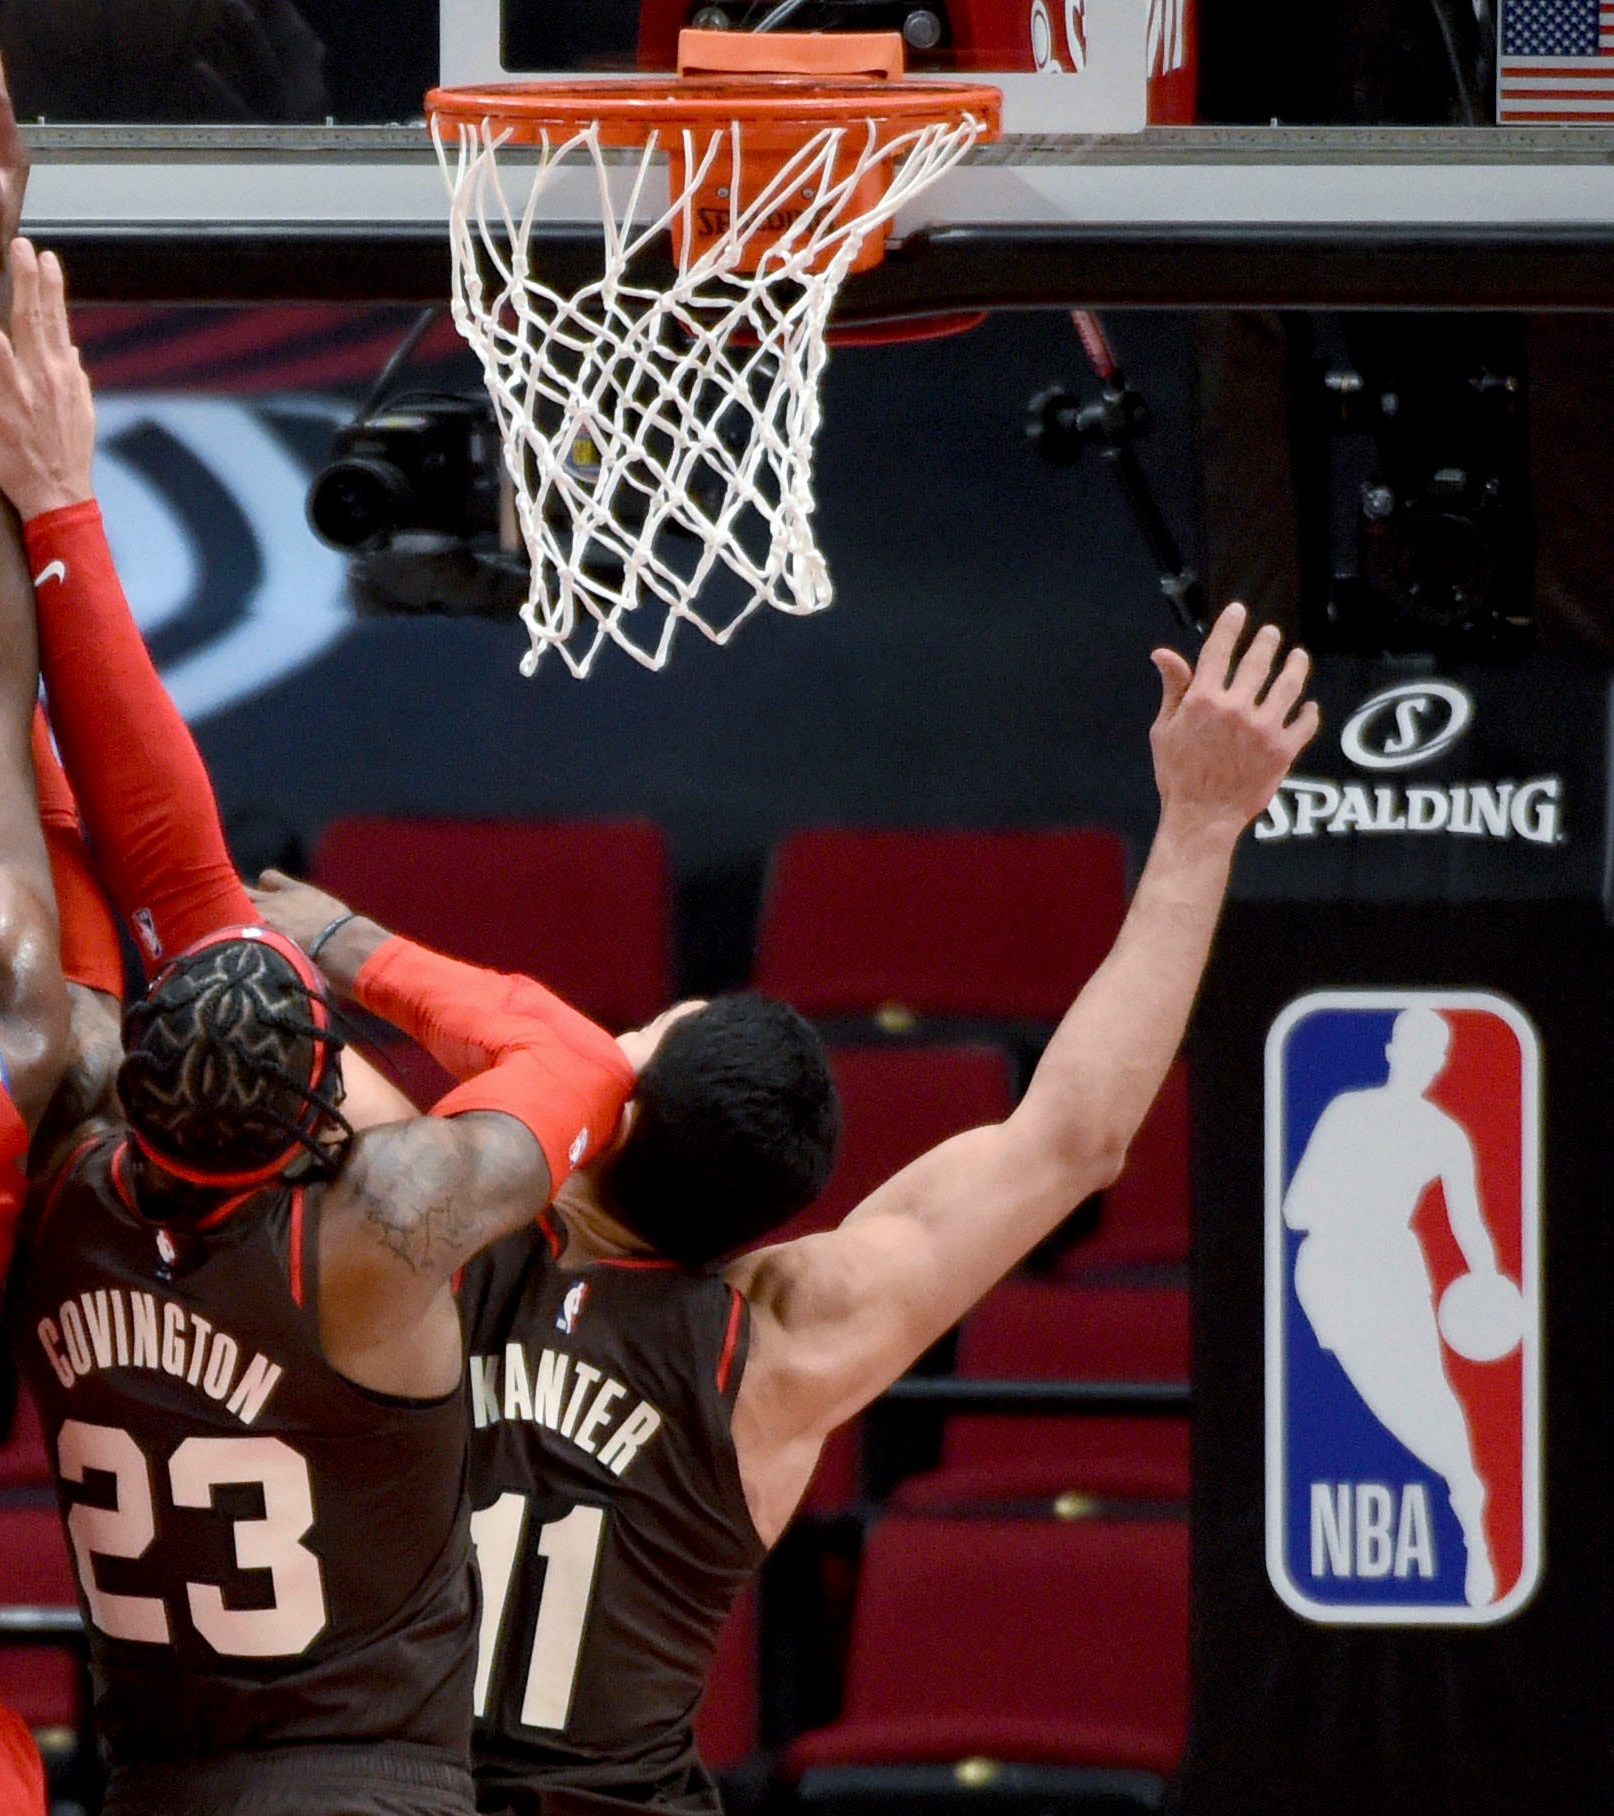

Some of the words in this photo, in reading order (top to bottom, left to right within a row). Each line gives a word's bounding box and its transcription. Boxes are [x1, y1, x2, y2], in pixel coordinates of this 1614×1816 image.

[1254, 778, 1559, 844] SPALDING
[37, 1289, 283, 1425] COVINGTON
[469, 1342, 661, 1477] KANTER
[57, 1418, 327, 1657] 23
[1309, 1483, 1434, 1578] NBA
[470, 1492, 605, 1731] 11
